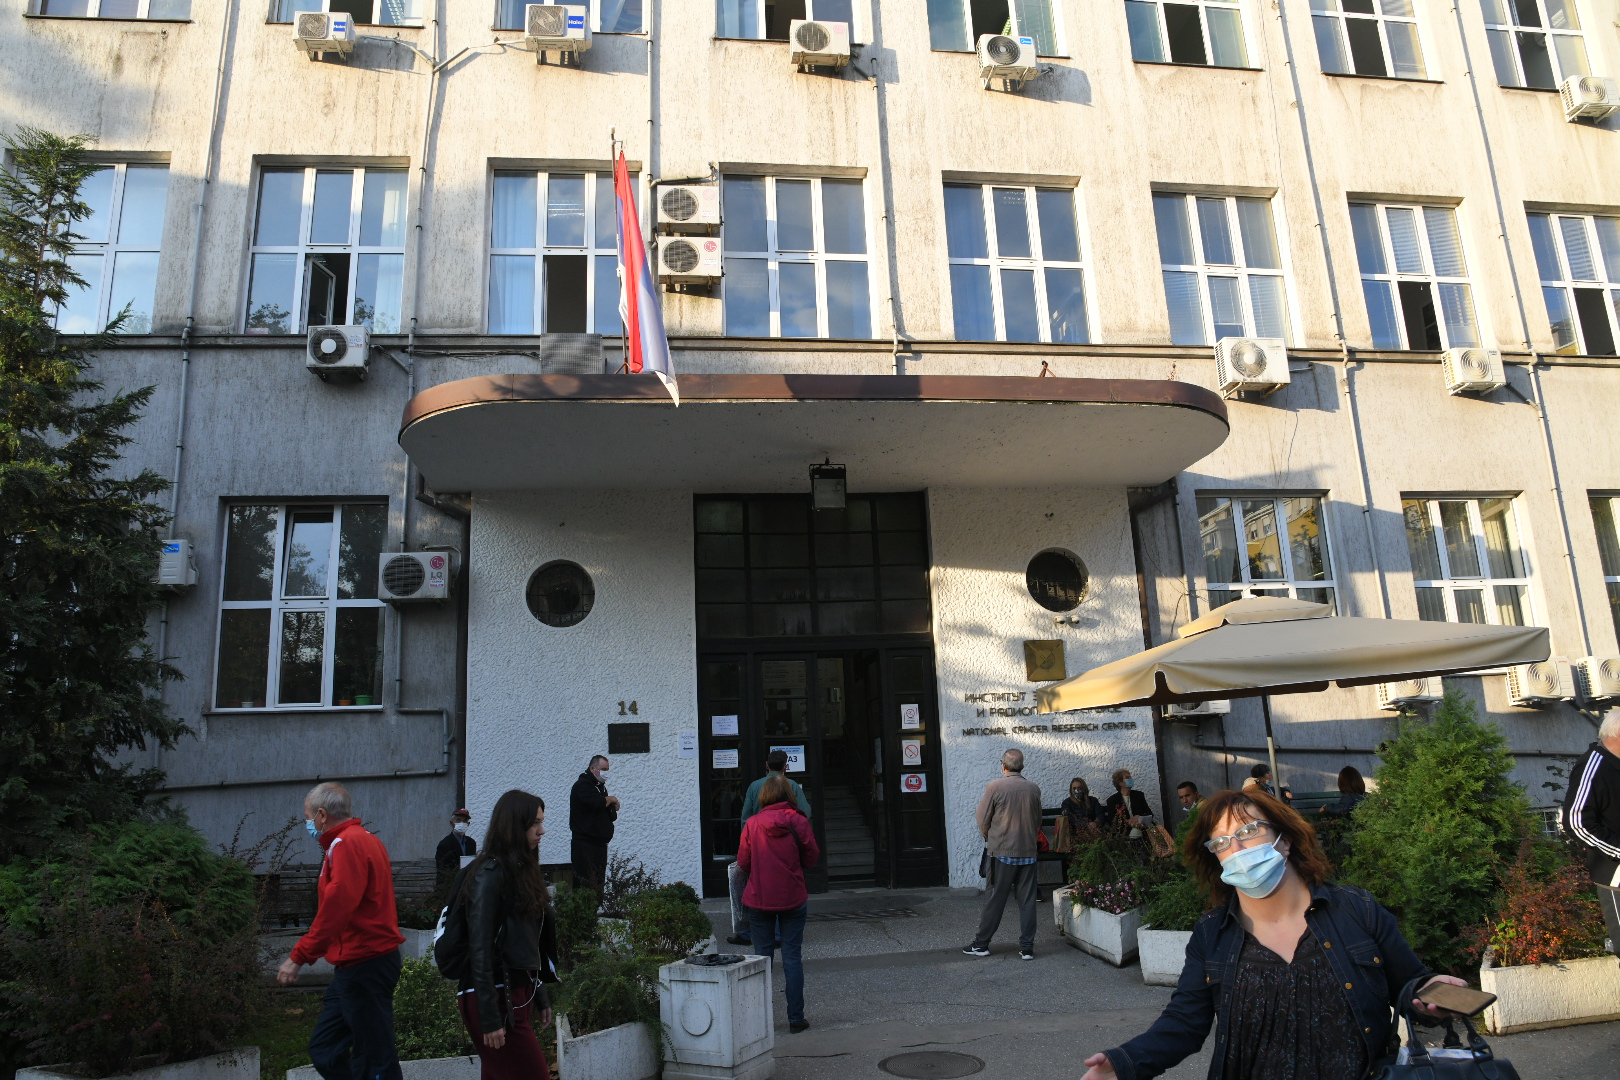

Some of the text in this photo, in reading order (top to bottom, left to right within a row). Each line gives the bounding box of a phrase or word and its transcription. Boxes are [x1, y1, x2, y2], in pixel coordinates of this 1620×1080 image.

[964, 691, 1027, 703] ИНСТИТУТ
[617, 700, 639, 716] 14
[976, 708, 985, 718] И
[962, 721, 1137, 737] NATIONAL CANCER RESEARCH CENTER
